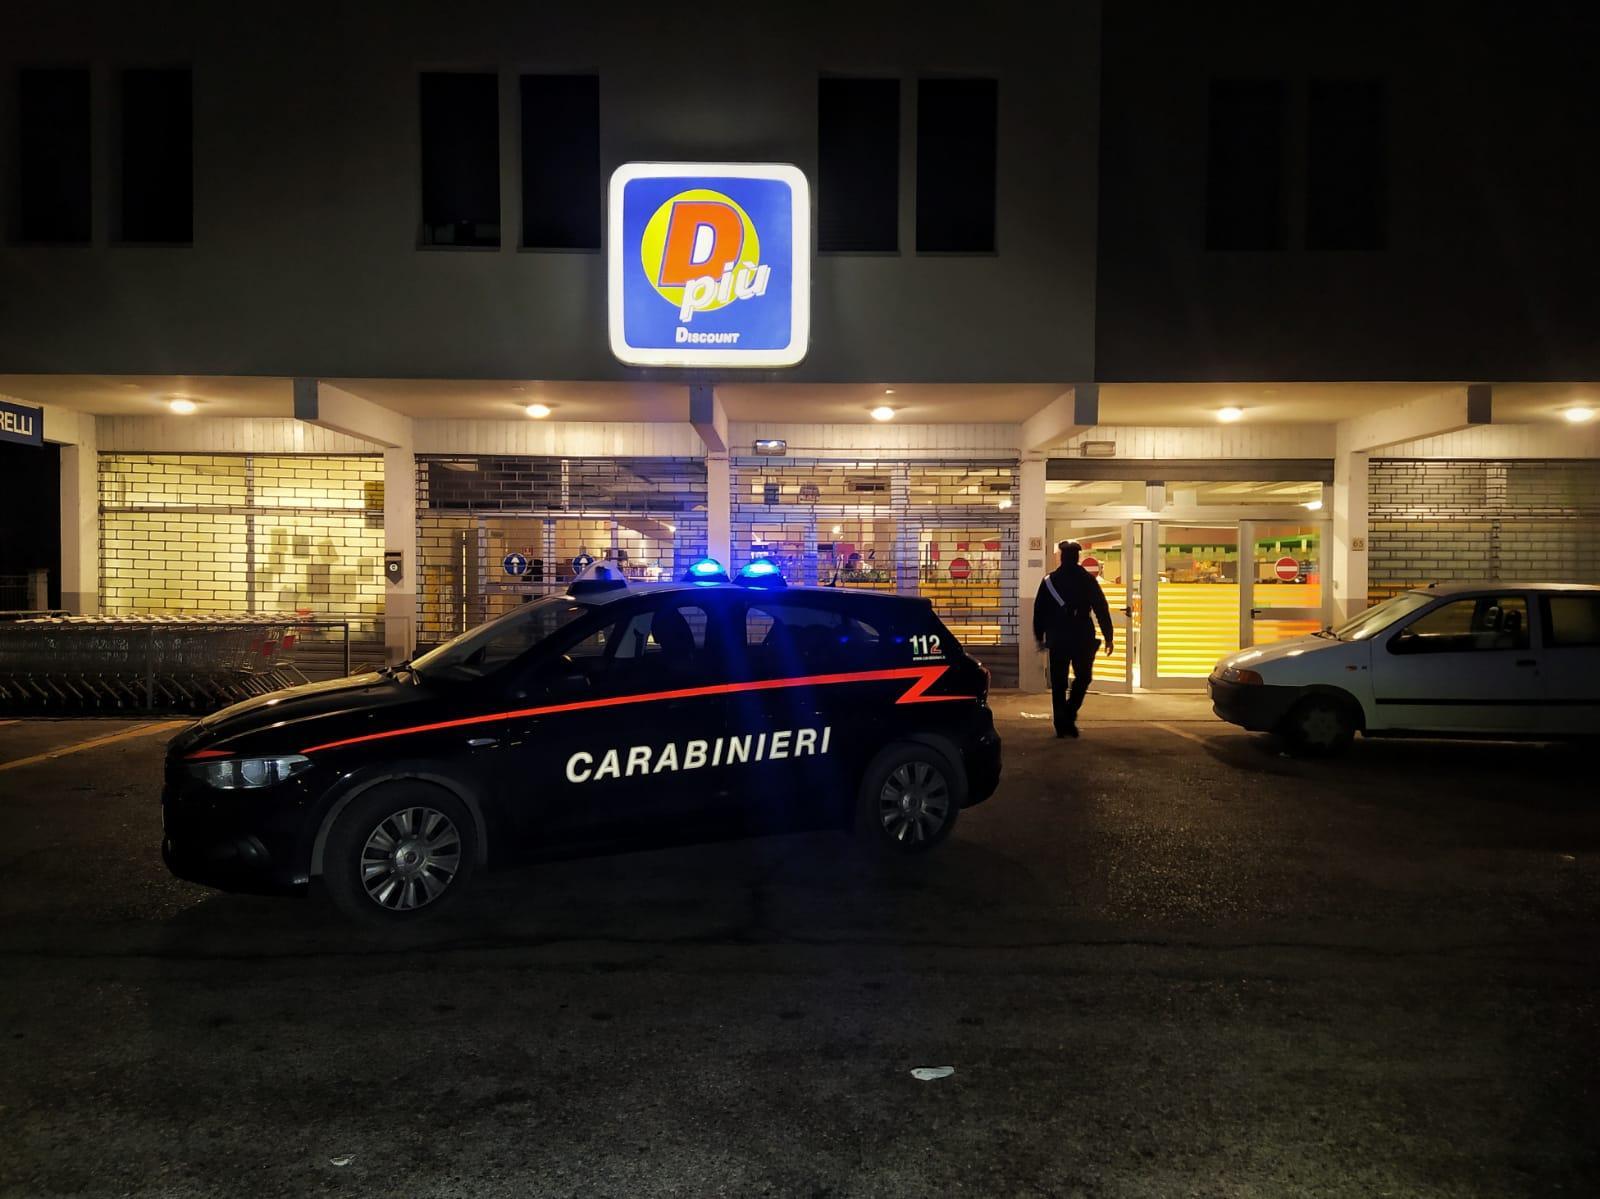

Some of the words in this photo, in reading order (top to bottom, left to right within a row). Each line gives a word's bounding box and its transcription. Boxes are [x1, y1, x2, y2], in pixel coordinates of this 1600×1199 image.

[657, 201, 744, 288] D
[679, 260, 771, 322] più
[675, 326, 740, 344] DISCOUNT
[909, 634, 942, 655] 112
[565, 726, 832, 784] CARABINIERI
